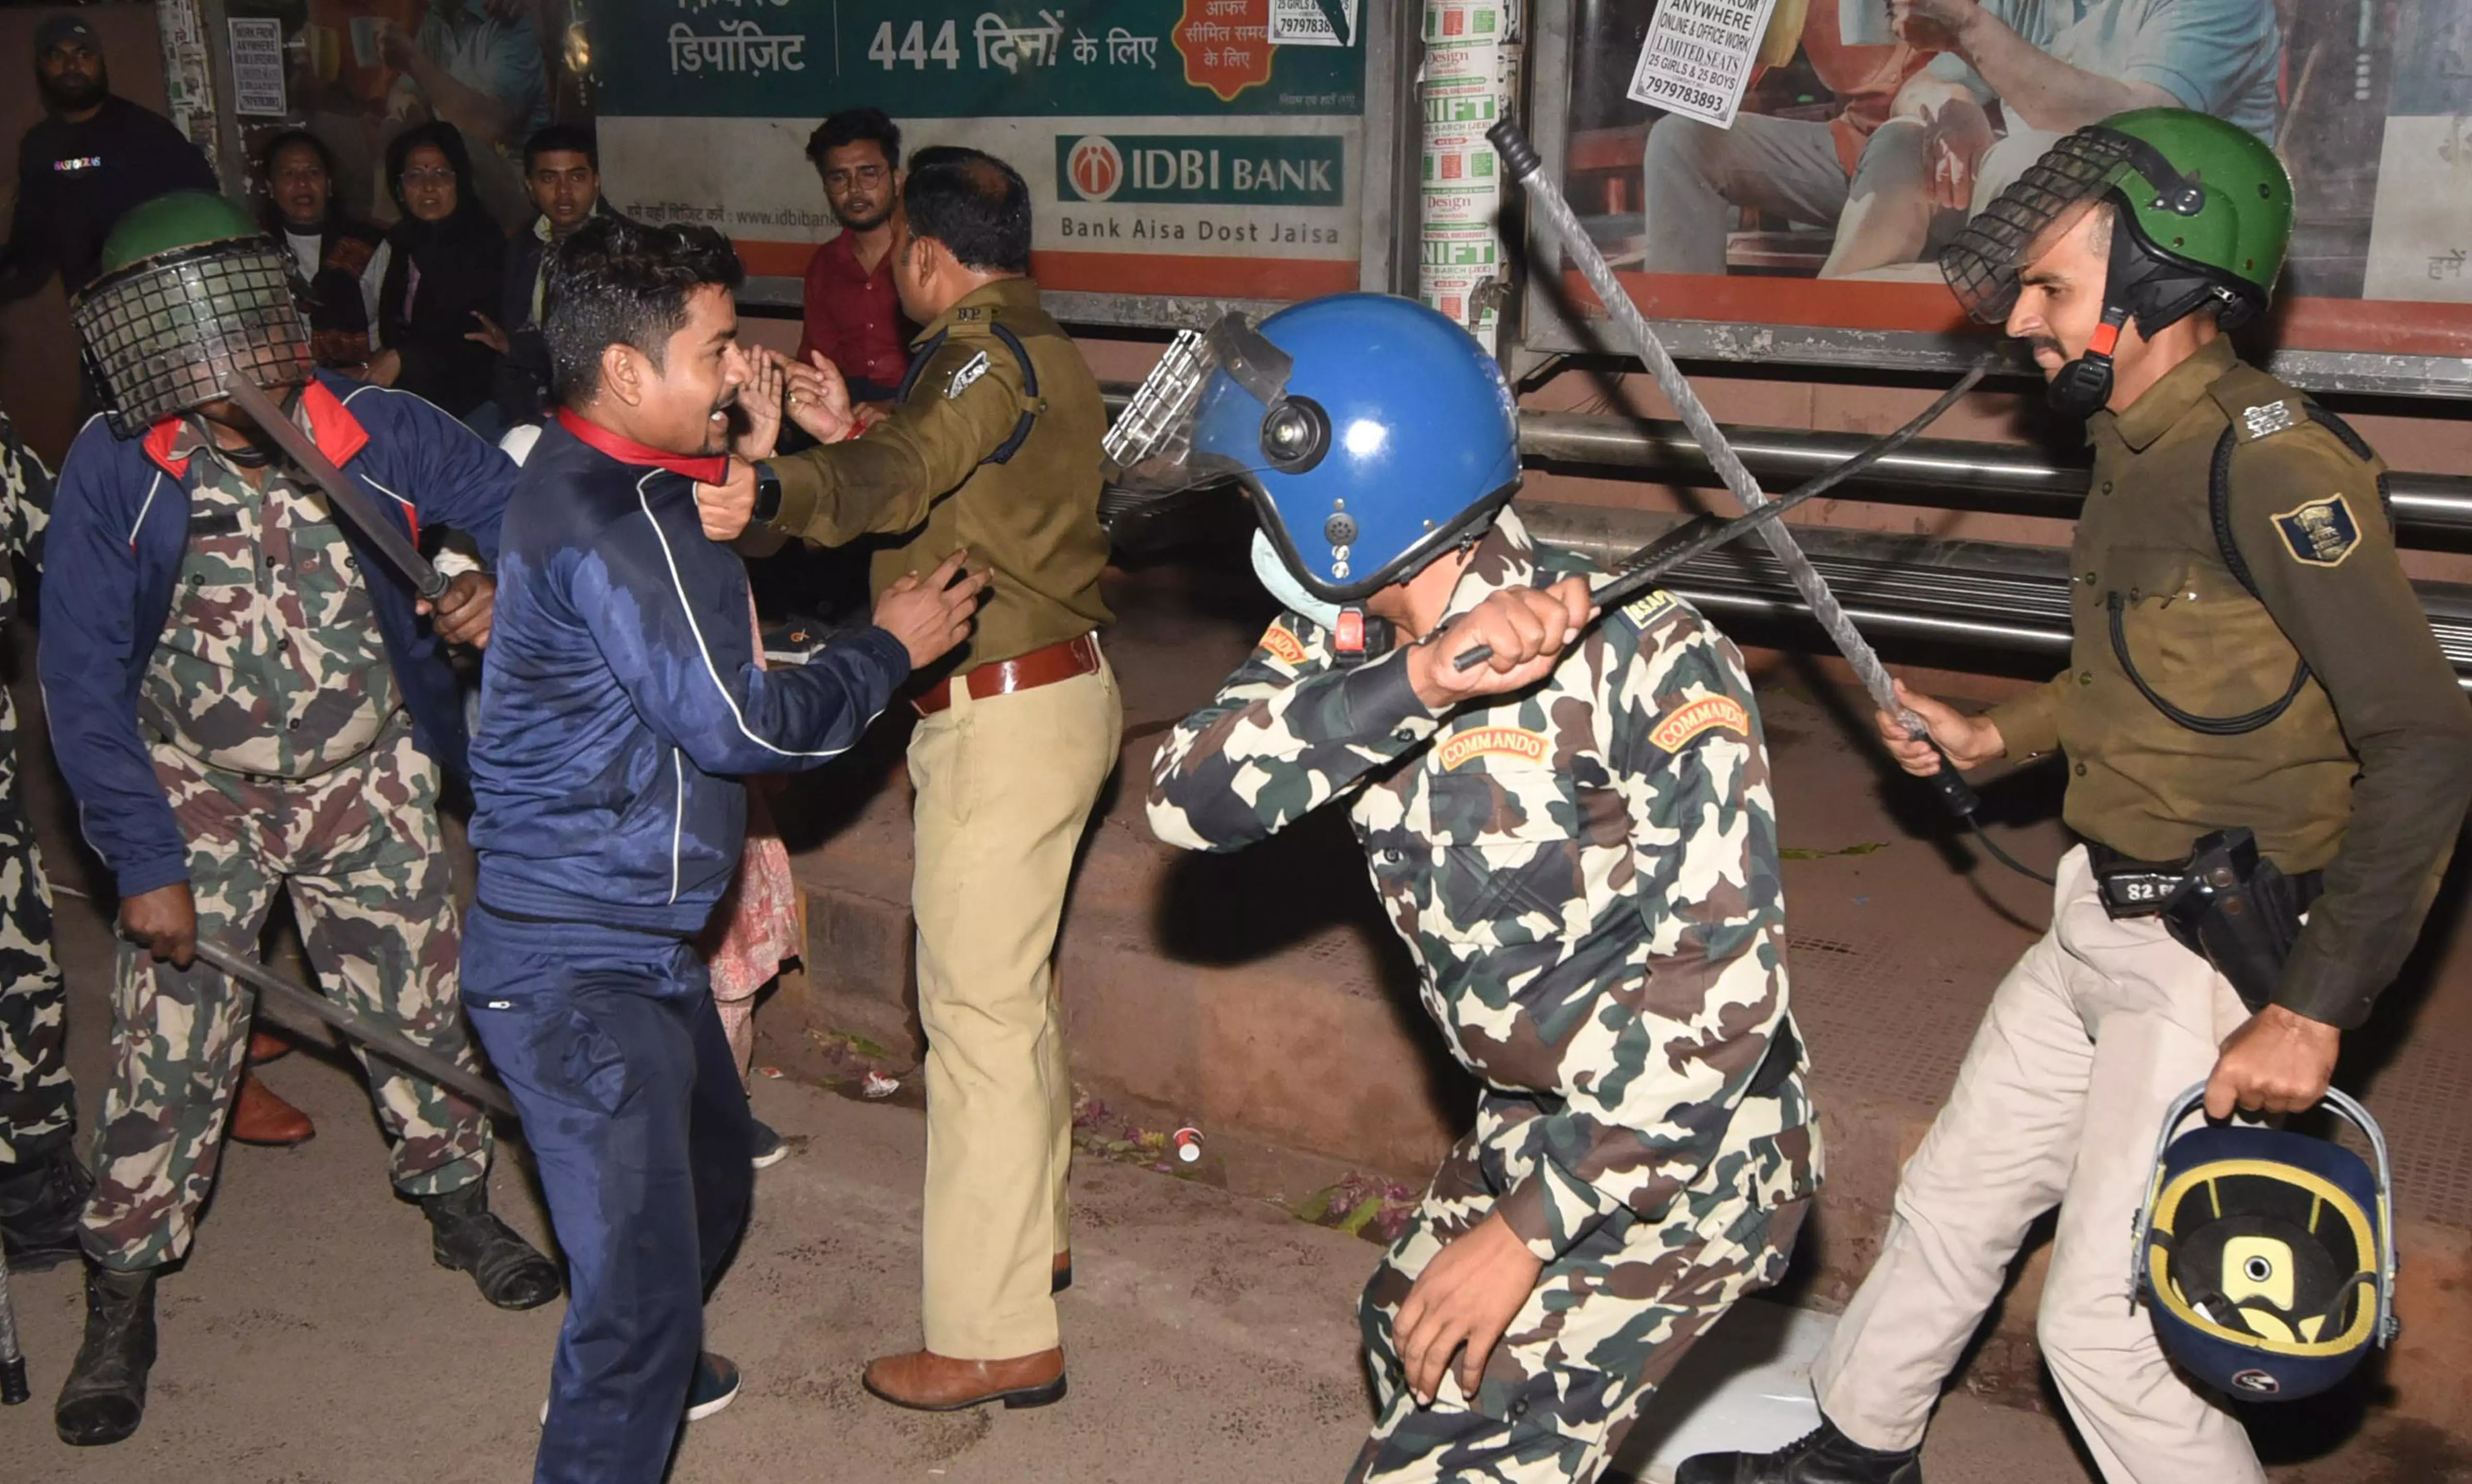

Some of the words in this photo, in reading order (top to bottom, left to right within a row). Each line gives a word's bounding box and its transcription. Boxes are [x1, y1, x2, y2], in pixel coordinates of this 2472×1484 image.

[1670, 0, 1753, 31] ANYWHERE
[868, 19, 960, 71] 444
[973, 9, 1064, 74] दिनों
[1072, 27, 1098, 65] के
[1106, 27, 1158, 70] लिए
[1184, 21, 1231, 43] सीमित
[1660, 12, 1690, 34] ONLINE
[1689, 21, 1696, 37] &
[1696, 23, 1725, 45] OFFICE
[1725, 31, 1752, 52] WORK
[1204, 47, 1219, 68] के
[1222, 46, 1250, 70] लिए
[1428, 50, 1469, 65] Design
[1656, 35, 1705, 62] LIMITED
[1704, 49, 1741, 74] SEATS
[1648, 53, 1660, 66] 25
[1660, 57, 1688, 76] GIRLS
[1688, 65, 1696, 78] &
[1697, 68, 1709, 81] 25
[1709, 72, 1736, 90] BOYS
[1423, 96, 1492, 122] NIFT
[1646, 76, 1723, 112] 7979783893
[1132, 149, 1220, 190] IDBI
[1232, 158, 1333, 191] BANK
[1427, 194, 1471, 211] Design
[1061, 217, 1121, 238] Bank
[1131, 219, 1185, 239] Aisa
[1198, 219, 1258, 242] Dost
[1269, 222, 1338, 244] Jaisa
[1421, 241, 1492, 264] NIFT
[2427, 248, 2467, 280] हमें
[1659, 702, 1744, 746] COMMANDO
[1444, 732, 1540, 763] COMMANDO
